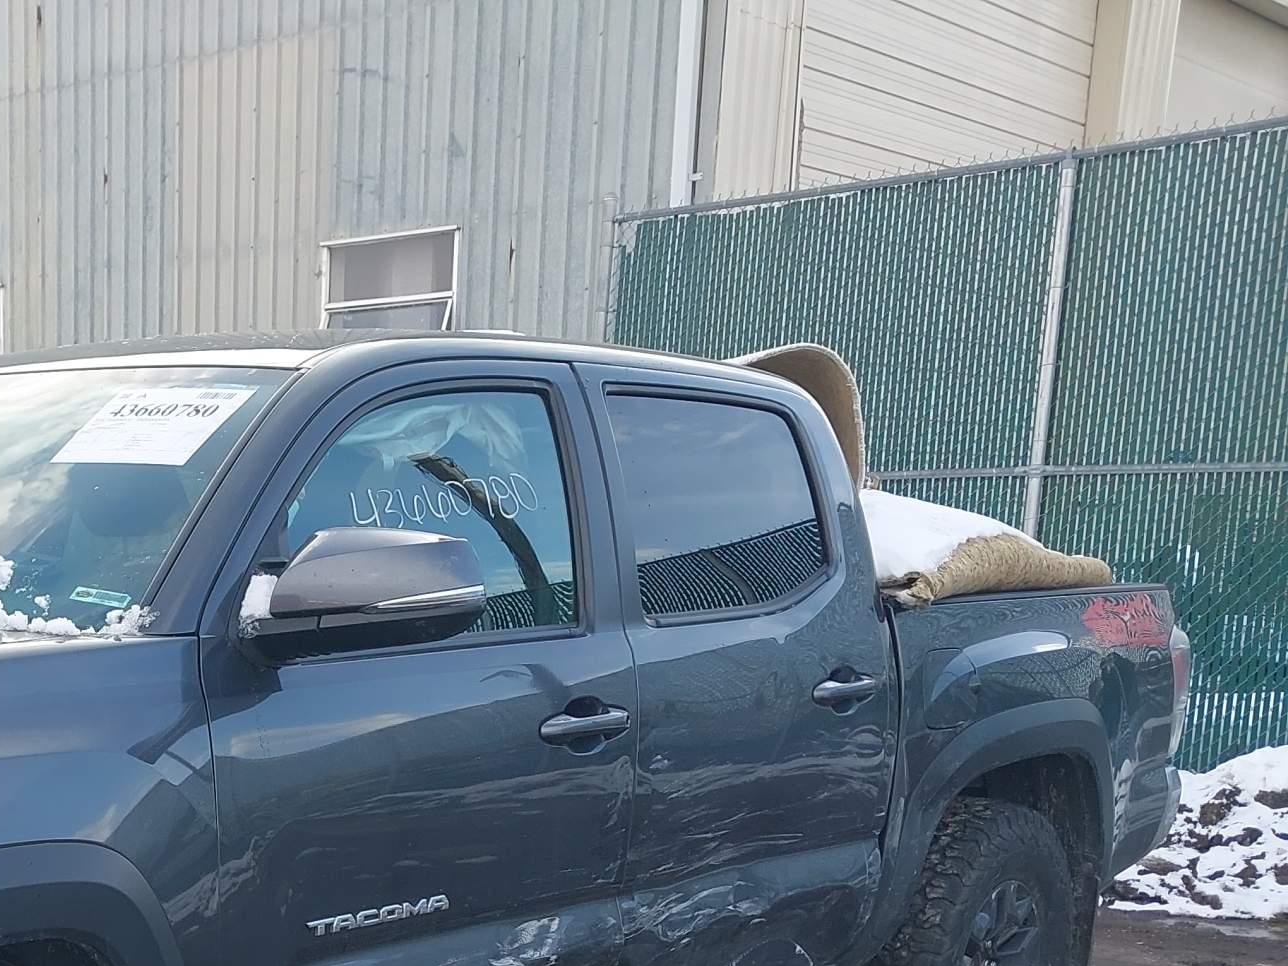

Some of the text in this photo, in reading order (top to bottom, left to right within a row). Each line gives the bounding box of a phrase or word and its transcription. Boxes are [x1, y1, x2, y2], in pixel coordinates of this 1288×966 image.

[109, 402, 220, 418] 43660780
[348, 472, 539, 529] 43660780
[304, 893, 450, 937] TACOMA
